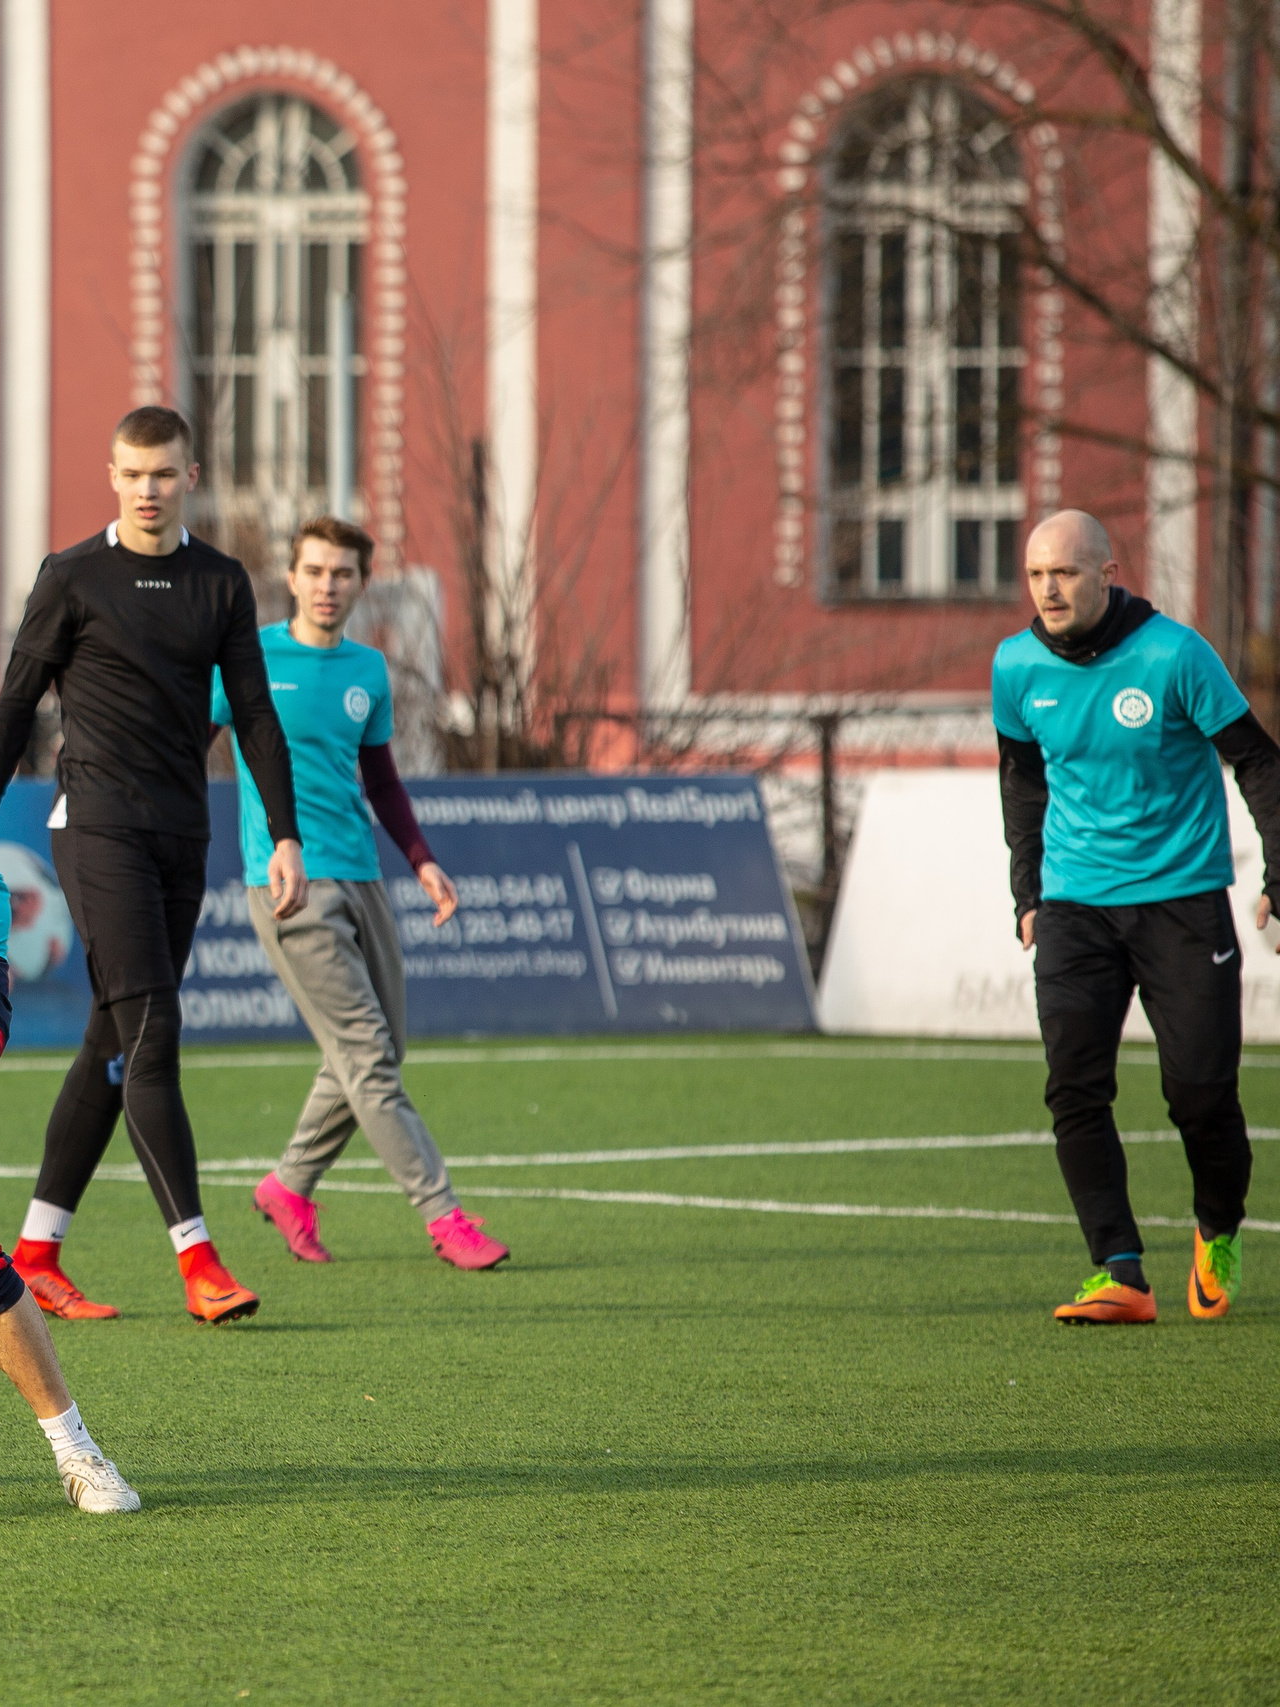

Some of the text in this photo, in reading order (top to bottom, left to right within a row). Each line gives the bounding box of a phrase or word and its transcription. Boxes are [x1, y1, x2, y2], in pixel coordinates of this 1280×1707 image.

[134, 579, 172, 589] KIPSTA
[545, 795, 626, 829] центр
[625, 786, 761, 829] RealSport
[623, 866, 718, 908] Форма
[634, 907, 789, 950] Атрибутика
[643, 951, 786, 989] Инвентарь
